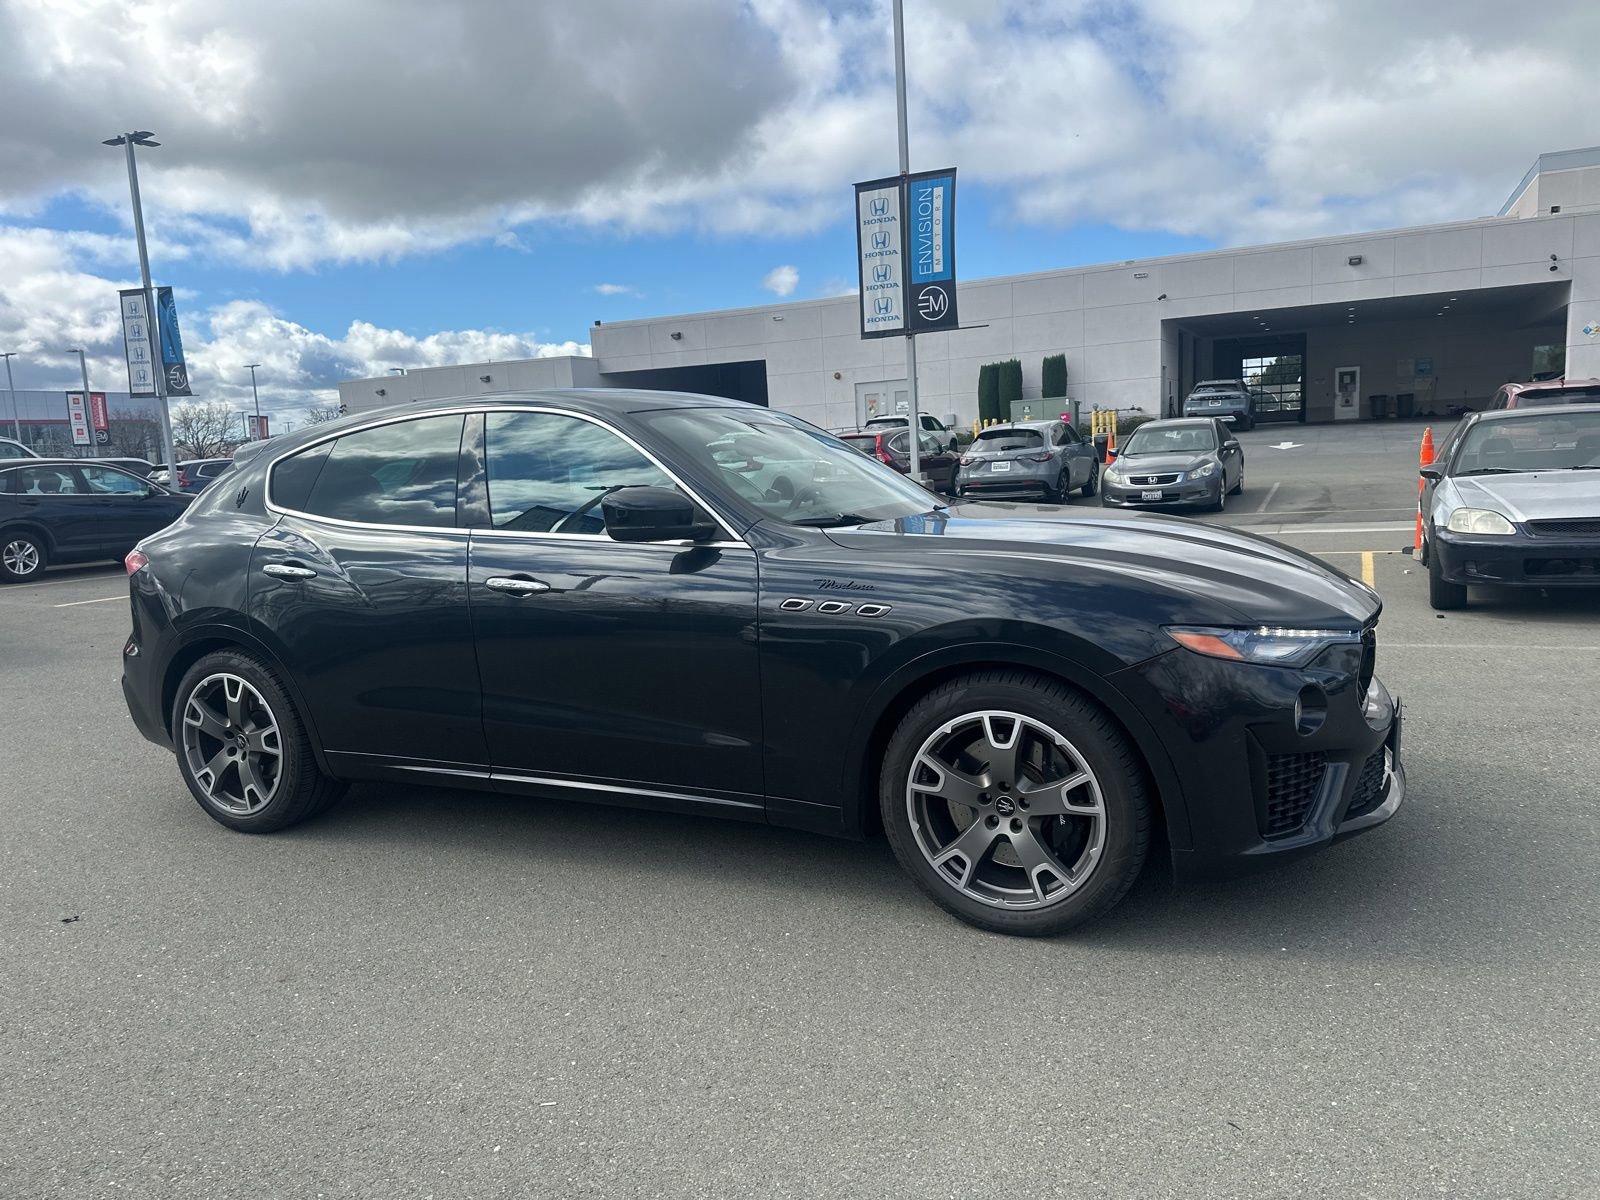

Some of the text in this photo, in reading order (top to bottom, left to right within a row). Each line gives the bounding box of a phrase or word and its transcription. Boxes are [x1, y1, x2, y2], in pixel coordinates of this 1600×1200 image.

[863, 216, 897, 226] HONDA
[918, 187, 932, 275] ENVISION
[934, 194, 942, 266] MOTORS
[864, 249, 899, 259] HONDA
[865, 282, 900, 291] HONDA
[867, 314, 900, 324] HONDA
[813, 579, 878, 591] Modena
